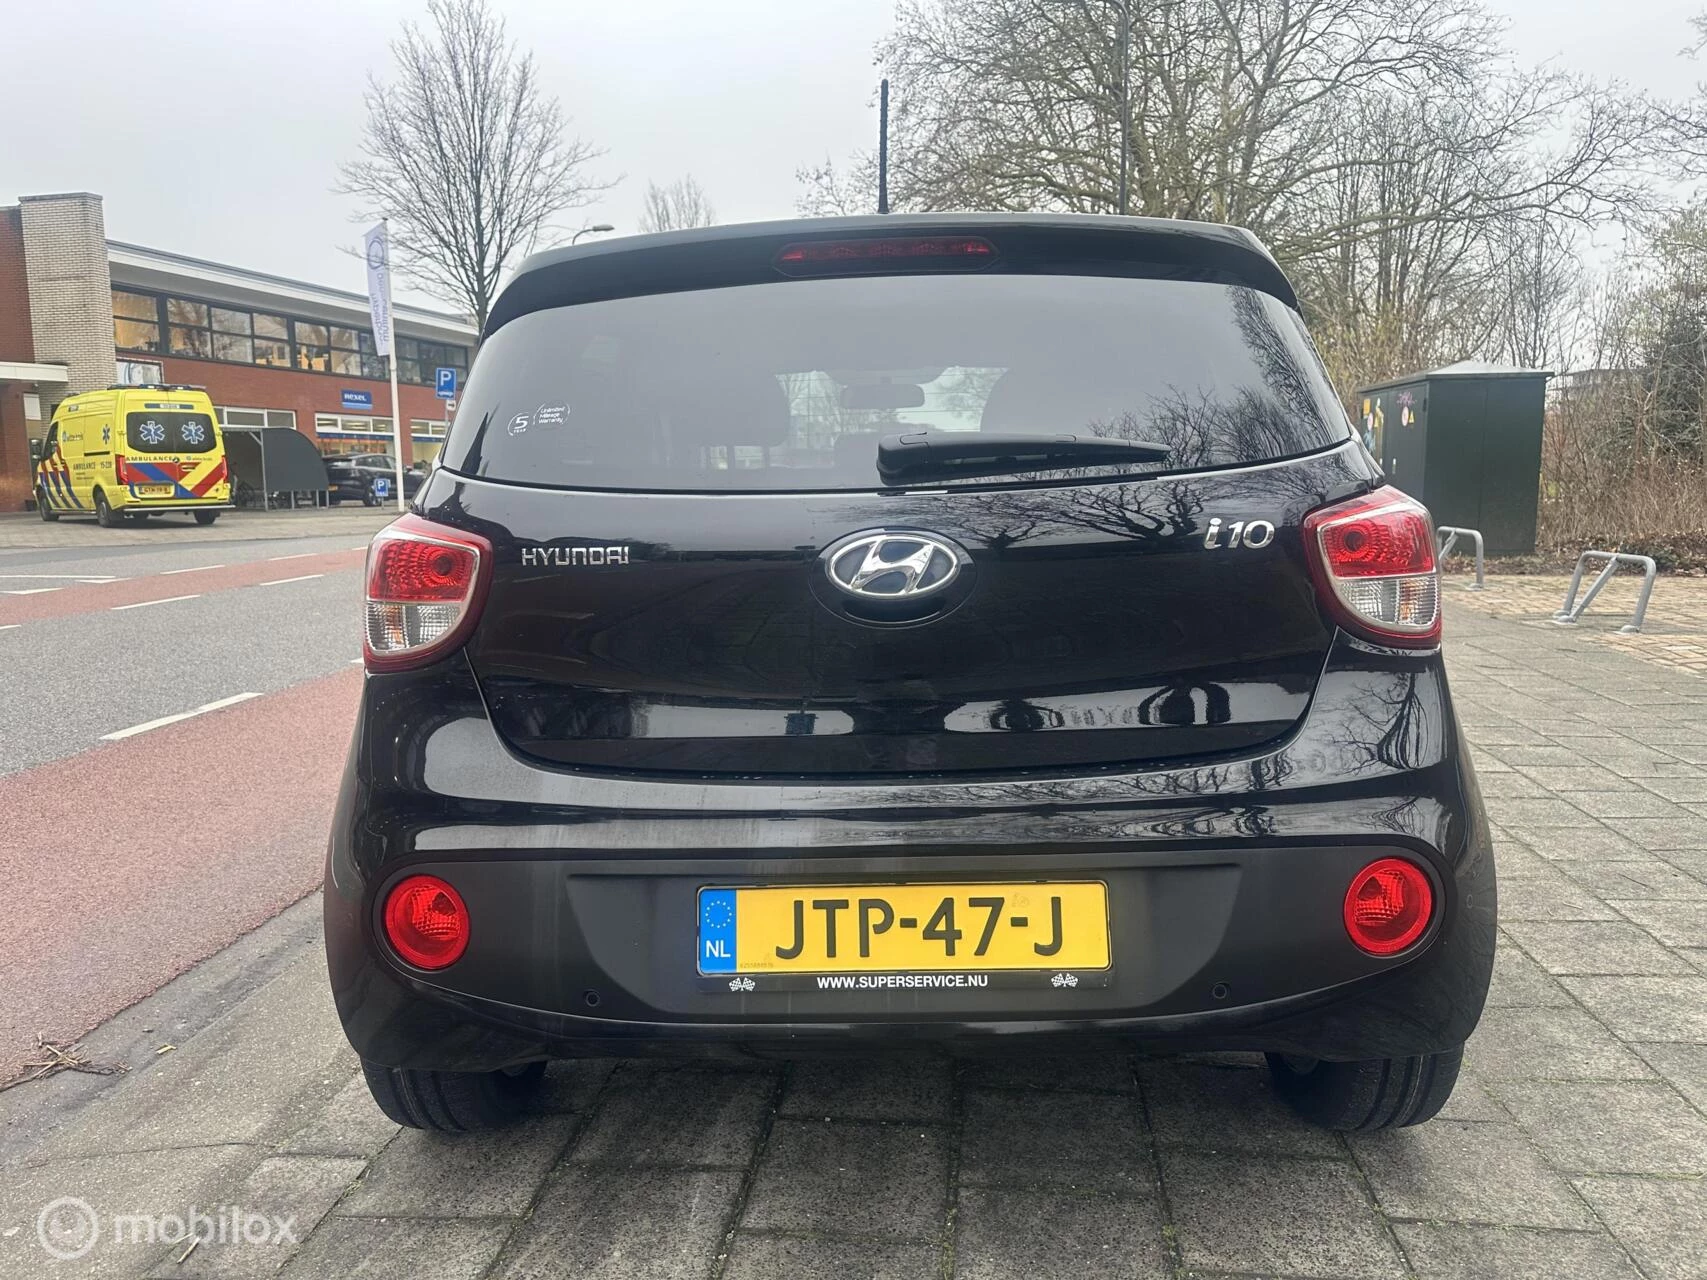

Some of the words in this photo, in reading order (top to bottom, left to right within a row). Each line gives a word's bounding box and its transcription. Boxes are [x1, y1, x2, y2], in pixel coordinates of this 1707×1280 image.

[440, 370, 452, 386] P
[514, 416, 529, 429] 5
[73, 462, 96, 470] AMBULANCE
[378, 481, 385, 490] P
[1204, 518, 1275, 549] i10
[522, 546, 629, 566] HYUNDAI
[705, 940, 731, 958] NL
[775, 896, 1063, 960] JTP-47-J
[816, 975, 989, 990] WWW.SUPERSERVICE.NU
